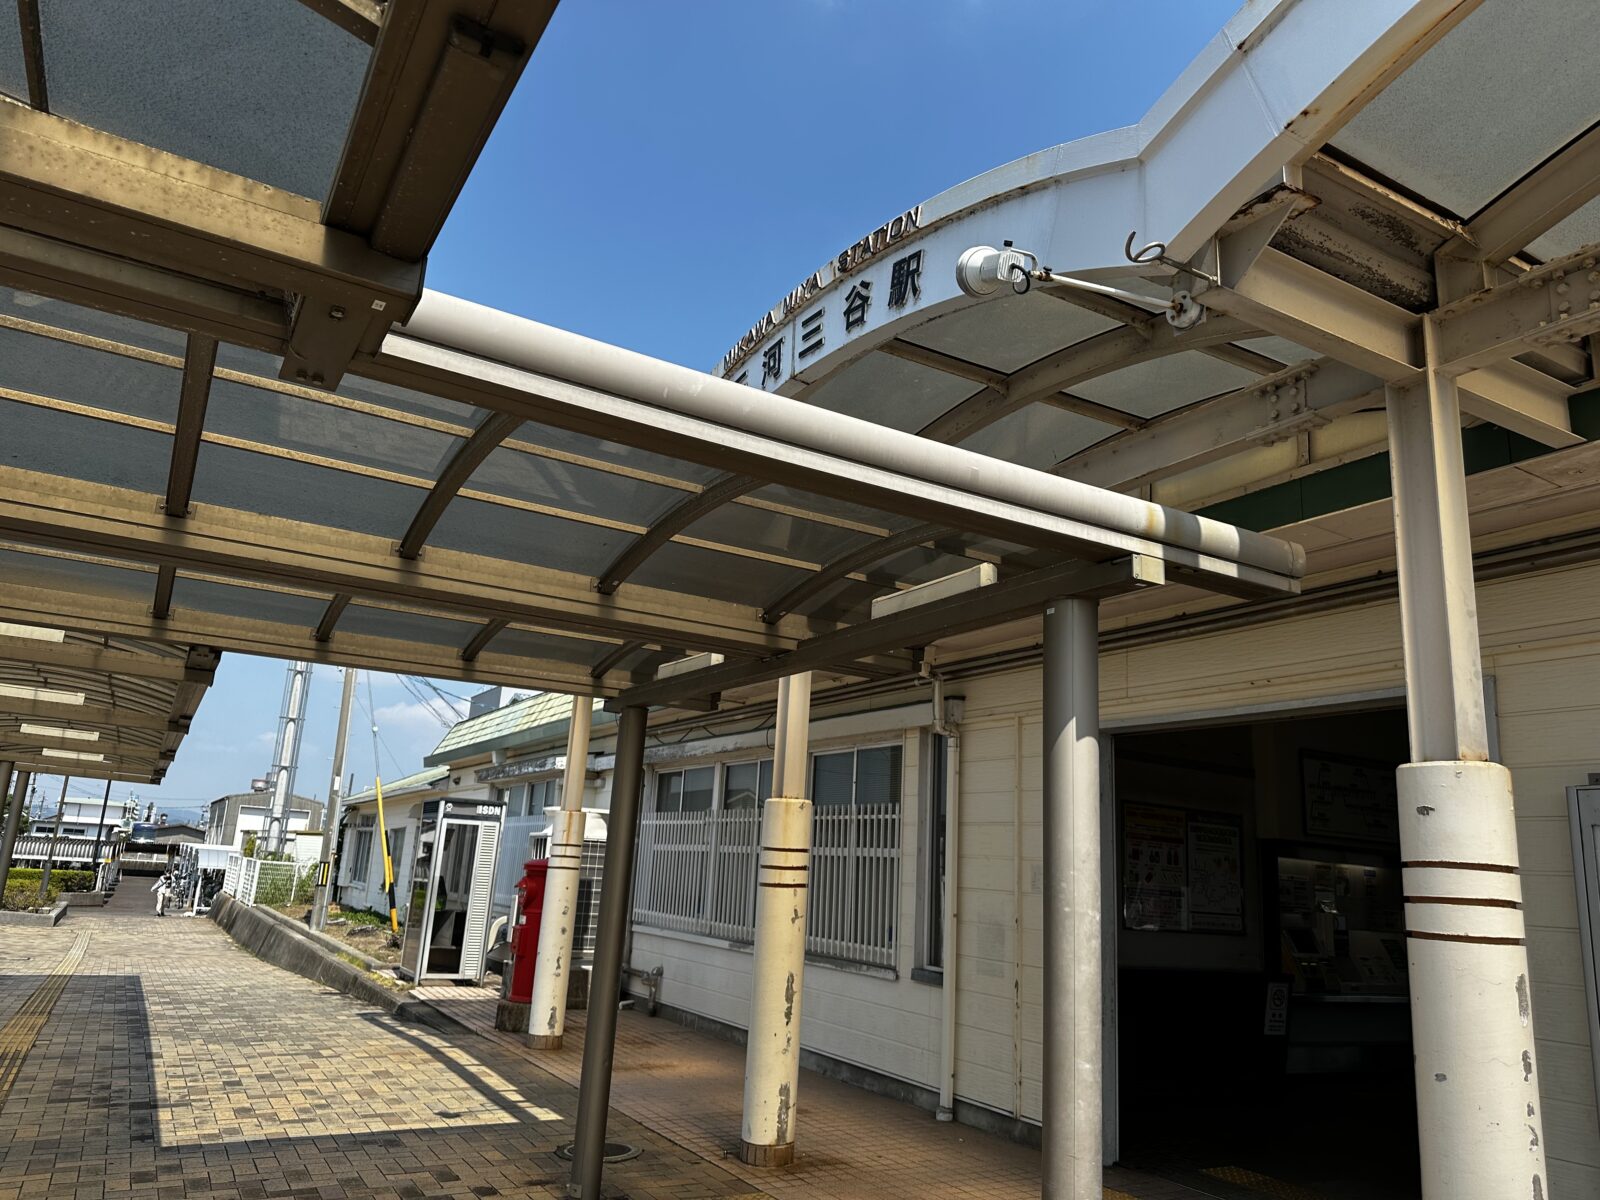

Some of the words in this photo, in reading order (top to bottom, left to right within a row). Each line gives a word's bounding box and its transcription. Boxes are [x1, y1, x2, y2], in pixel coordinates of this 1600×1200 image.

[723, 311, 776, 370] MIKAWA
[783, 272, 822, 314] MIYA
[837, 206, 922, 273] STATION
[476, 805, 501, 816] ISDN
